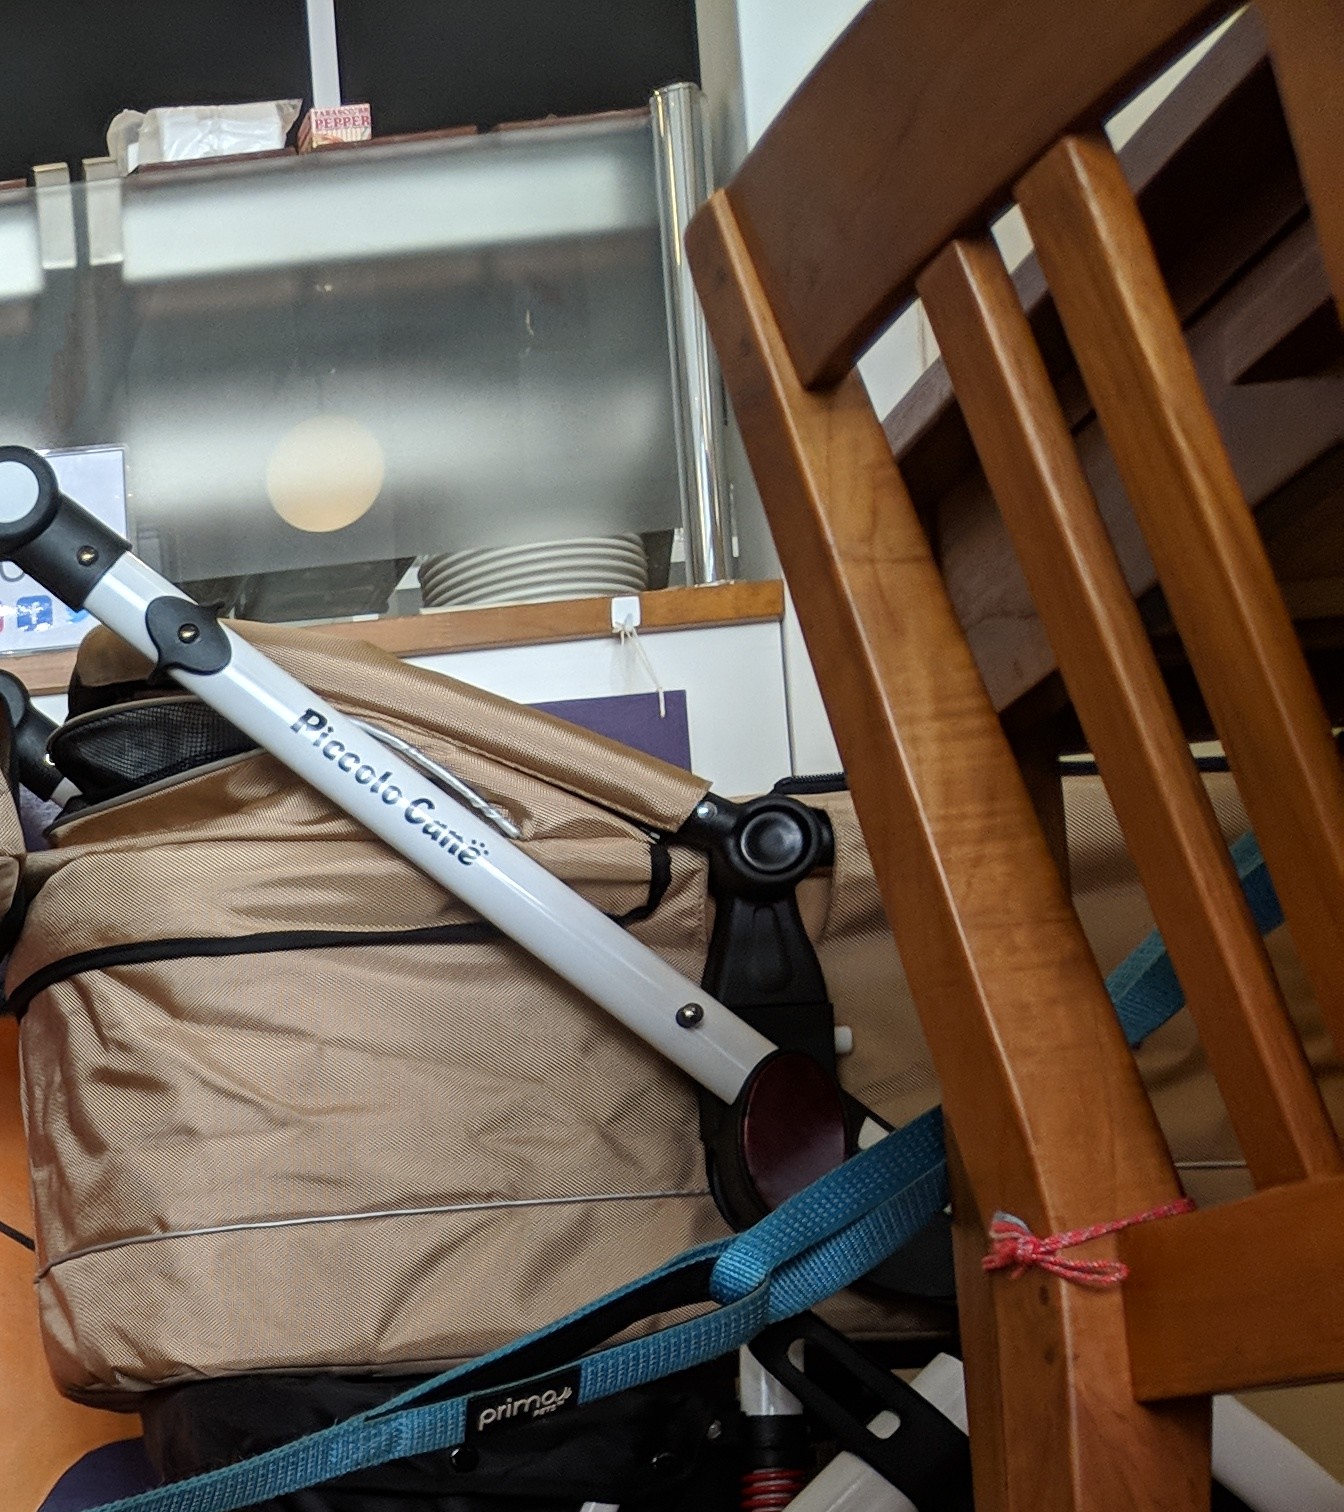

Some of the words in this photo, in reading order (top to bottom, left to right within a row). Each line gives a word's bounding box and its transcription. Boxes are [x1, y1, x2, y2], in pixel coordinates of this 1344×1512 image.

[314, 115, 370, 129] PEPPER
[289, 707, 403, 806] Piccolo
[478, 1390, 556, 1431] primo
